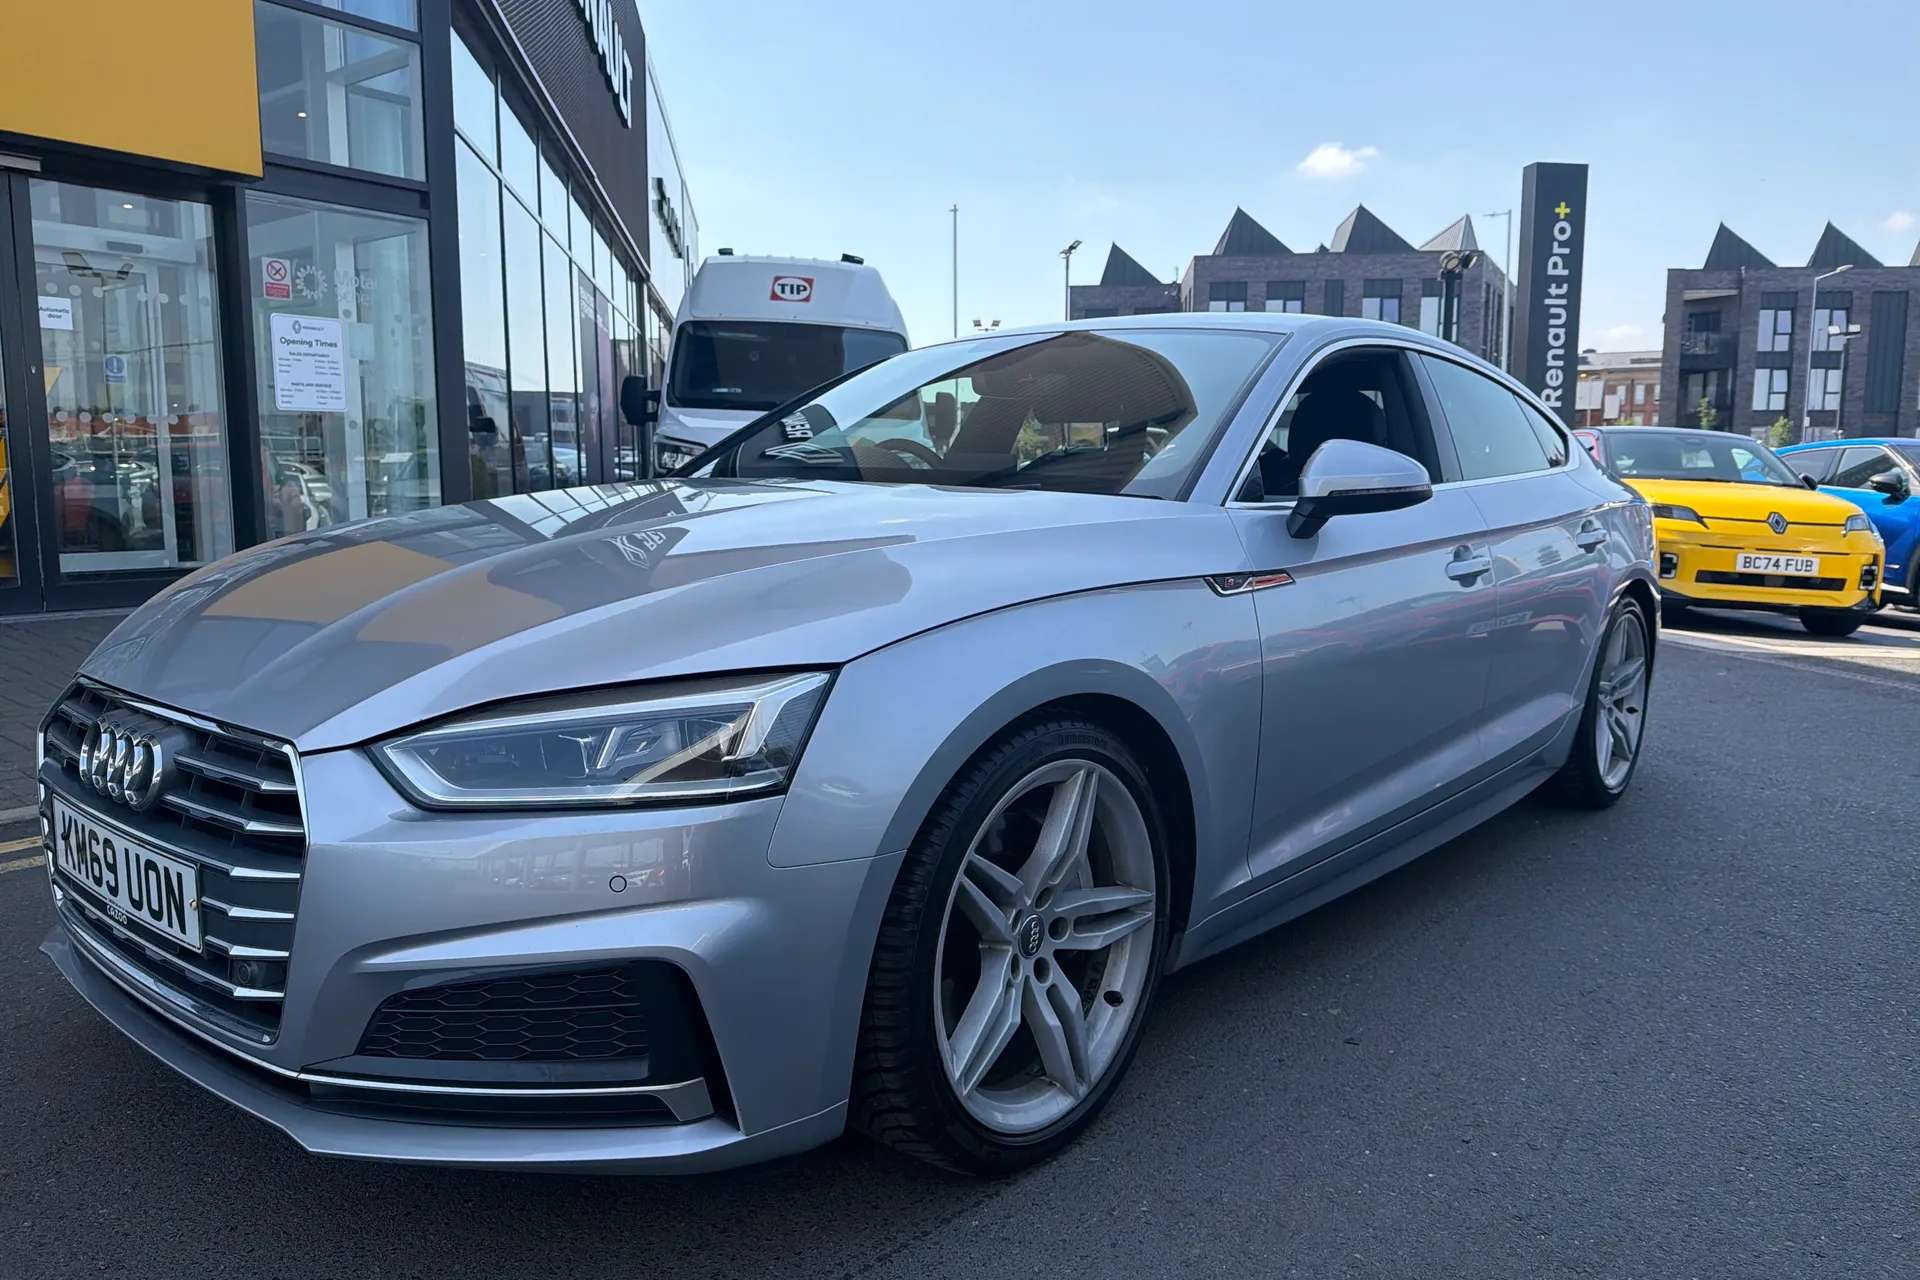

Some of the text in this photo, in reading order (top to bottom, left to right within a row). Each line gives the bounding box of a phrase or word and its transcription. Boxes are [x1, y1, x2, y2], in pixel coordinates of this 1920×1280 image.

[777, 283, 808, 295] TIP
[280, 336, 338, 348] Opening Times
[1541, 283, 1569, 408] Renault
[1743, 556, 1814, 573] BC74 FUB
[61, 810, 187, 936] KM69 UON
